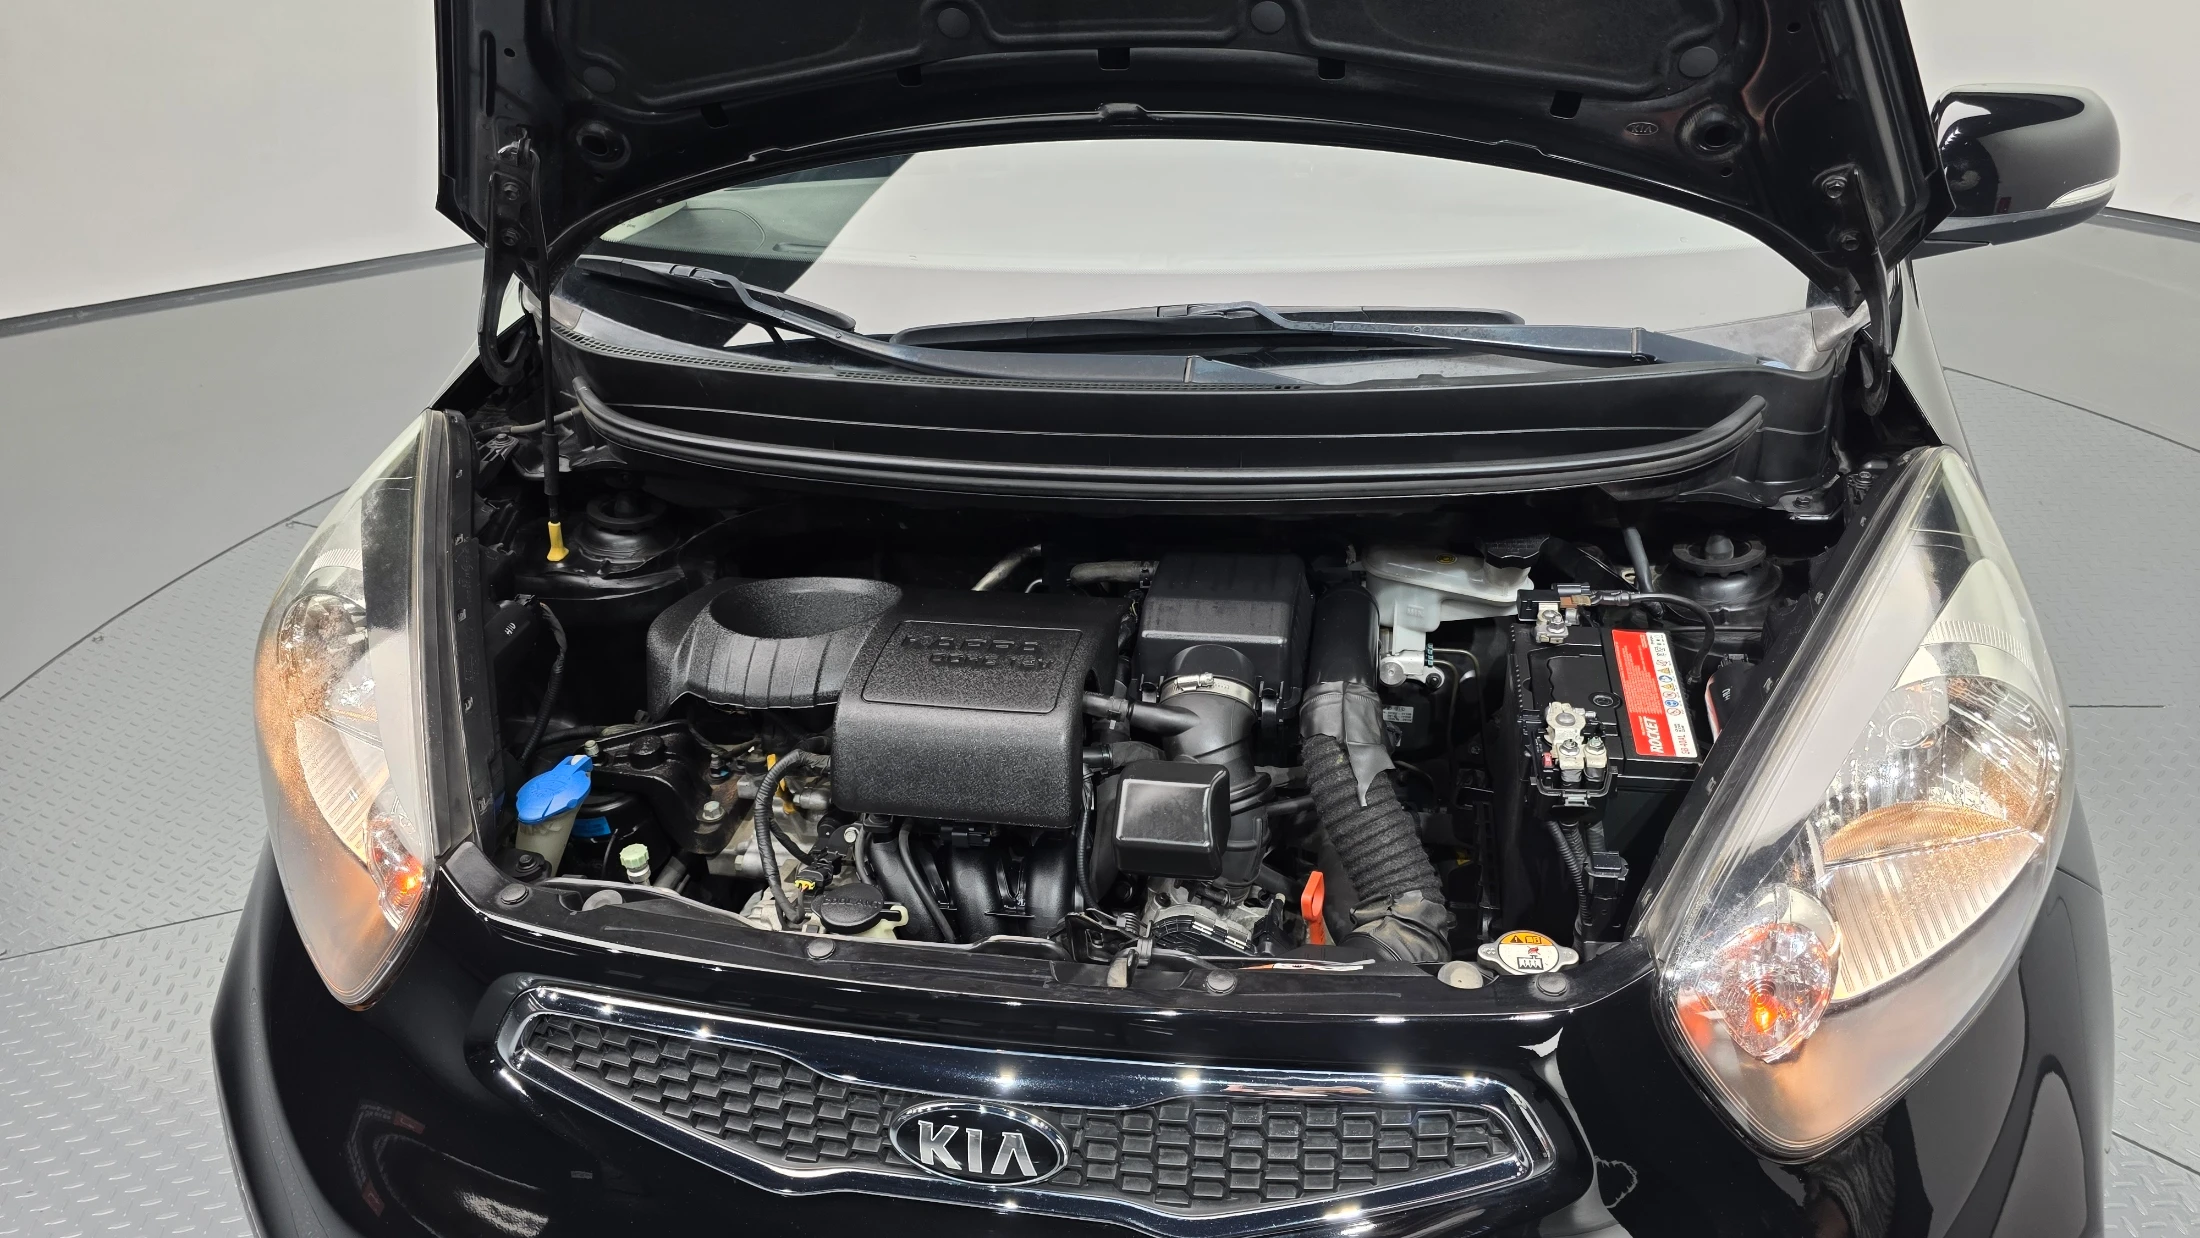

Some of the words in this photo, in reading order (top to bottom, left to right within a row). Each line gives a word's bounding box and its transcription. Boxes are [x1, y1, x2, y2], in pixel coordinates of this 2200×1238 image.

[1631, 124, 1653, 134] KIA
[1643, 715, 1664, 754] ROCKET
[918, 1120, 1037, 1176] KIA
